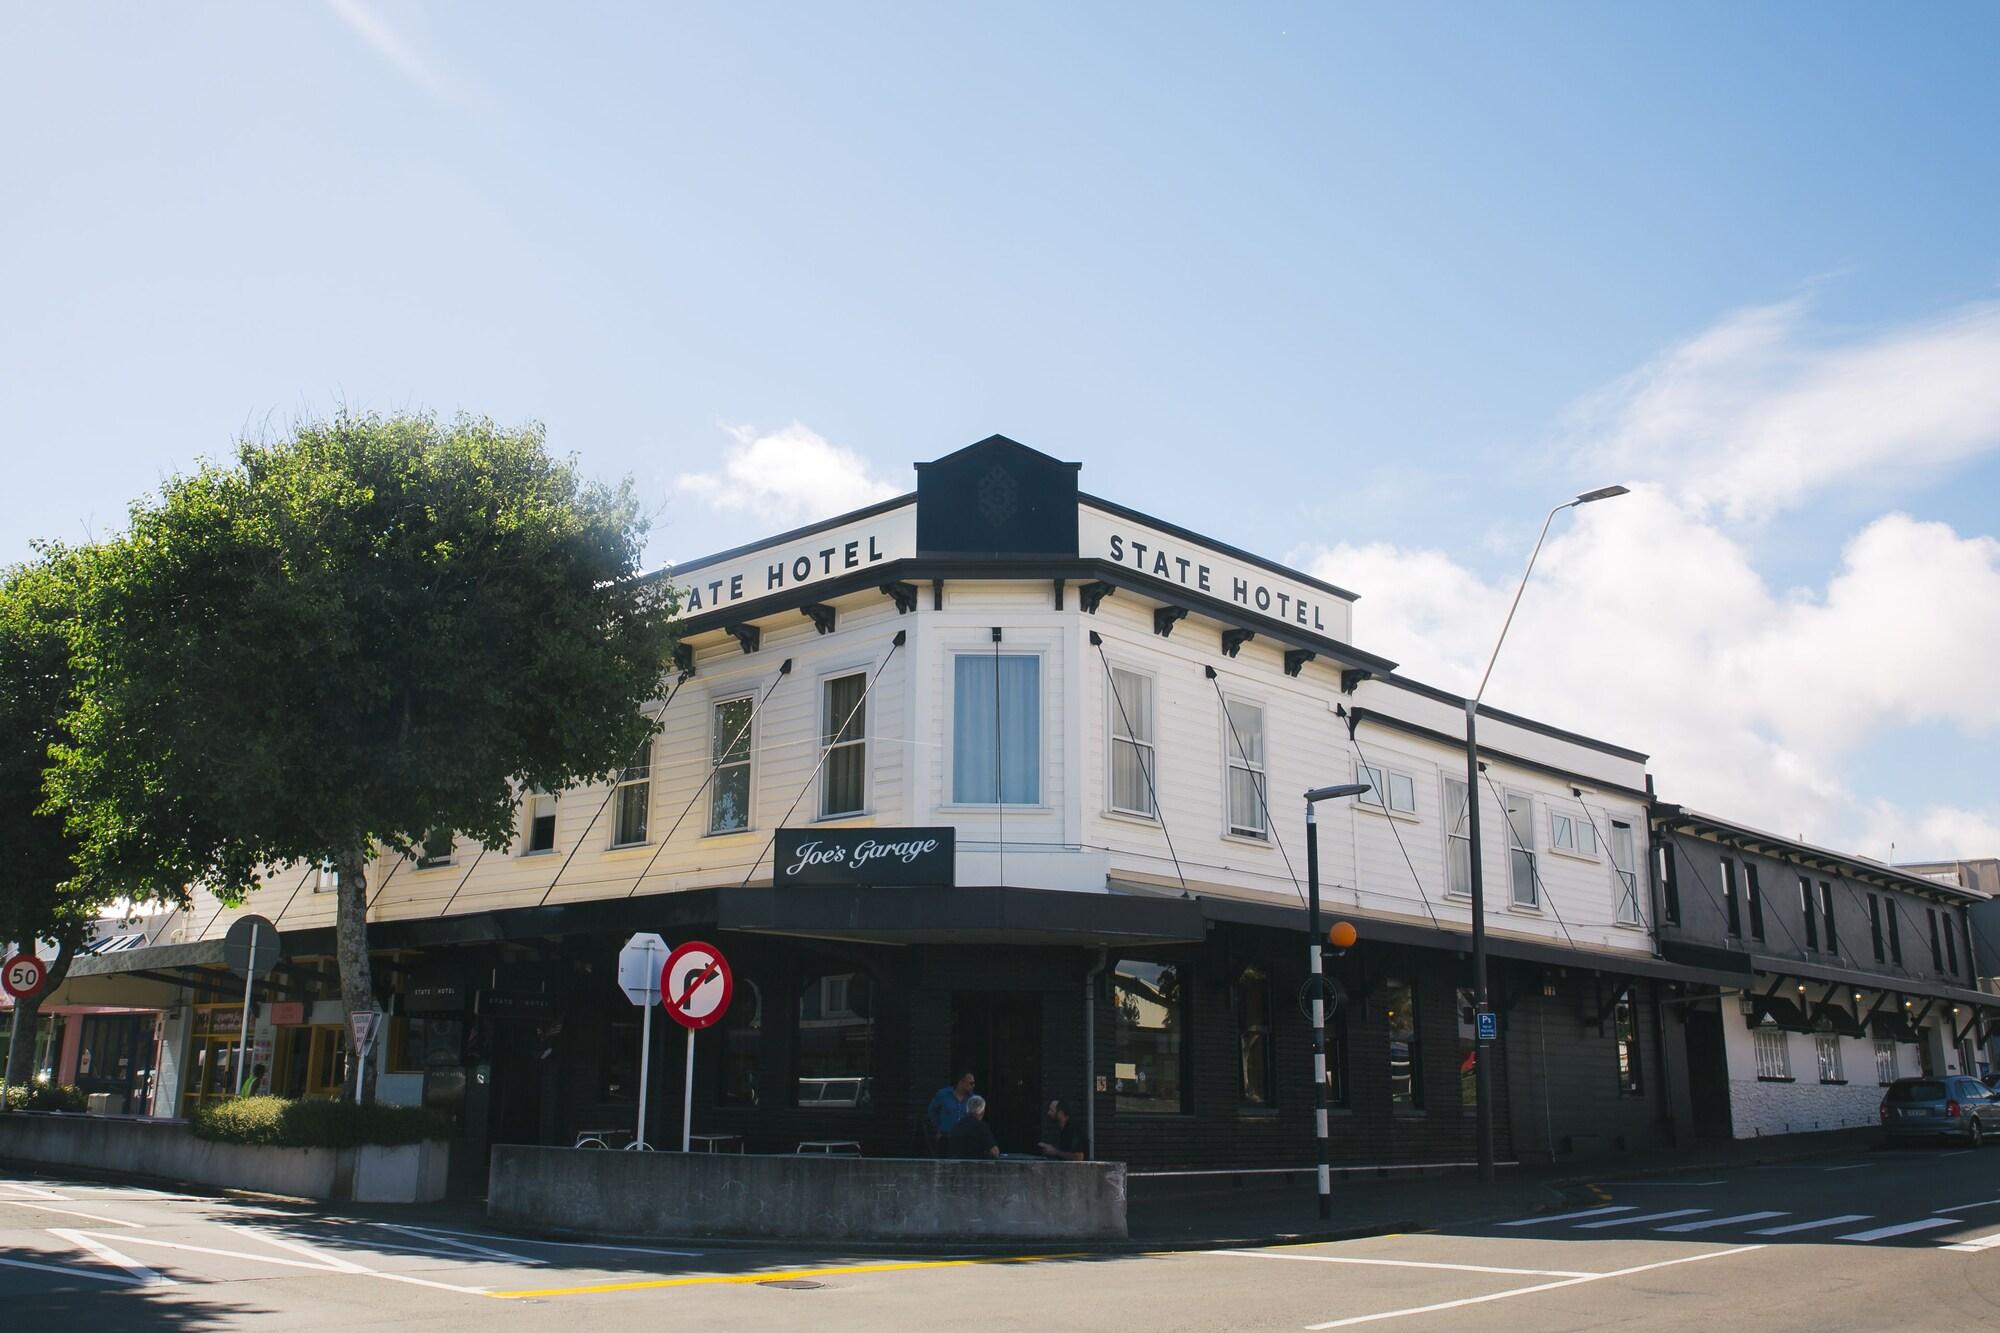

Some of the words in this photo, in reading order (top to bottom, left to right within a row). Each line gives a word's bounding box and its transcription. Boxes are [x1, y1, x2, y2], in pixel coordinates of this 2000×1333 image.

[686, 574, 743, 613] ATE
[767, 535, 883, 590] HOTEL
[1110, 534, 1211, 592] STATE
[1232, 576, 1325, 631] HOTEL
[785, 840, 847, 876] Joe's
[848, 839, 940, 869] Garage
[12, 968, 37, 985] 50
